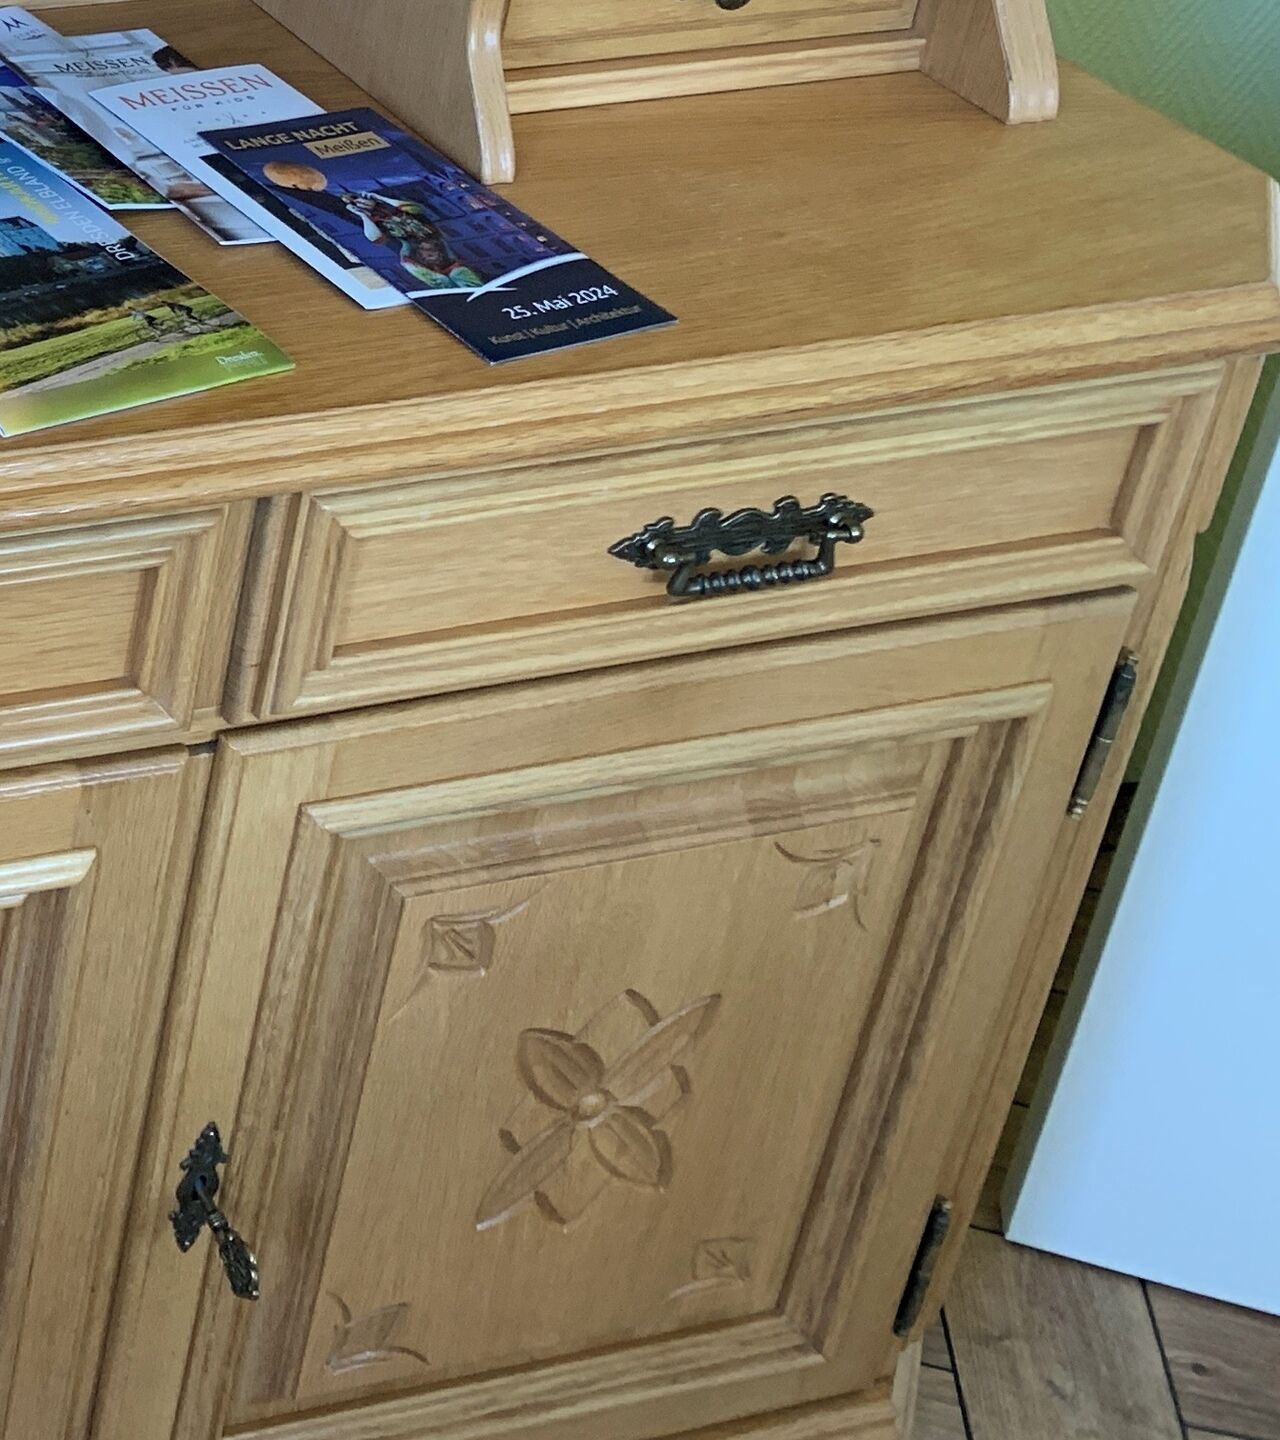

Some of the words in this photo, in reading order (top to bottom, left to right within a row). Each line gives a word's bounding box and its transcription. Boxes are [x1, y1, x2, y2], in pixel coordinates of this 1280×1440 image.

[53, 55, 152, 73] MEISSEN
[117, 74, 274, 110] MEISSEN
[224, 133, 295, 151] LANGE
[291, 121, 359, 143] NACHT
[314, 137, 382, 156] Meißen
[6, 166, 73, 210] ELBLAND
[66, 209, 137, 261] DRESDEN
[502, 305, 537, 320] 25.
[533, 295, 574, 314] Mai
[568, 284, 619, 304] 2024
